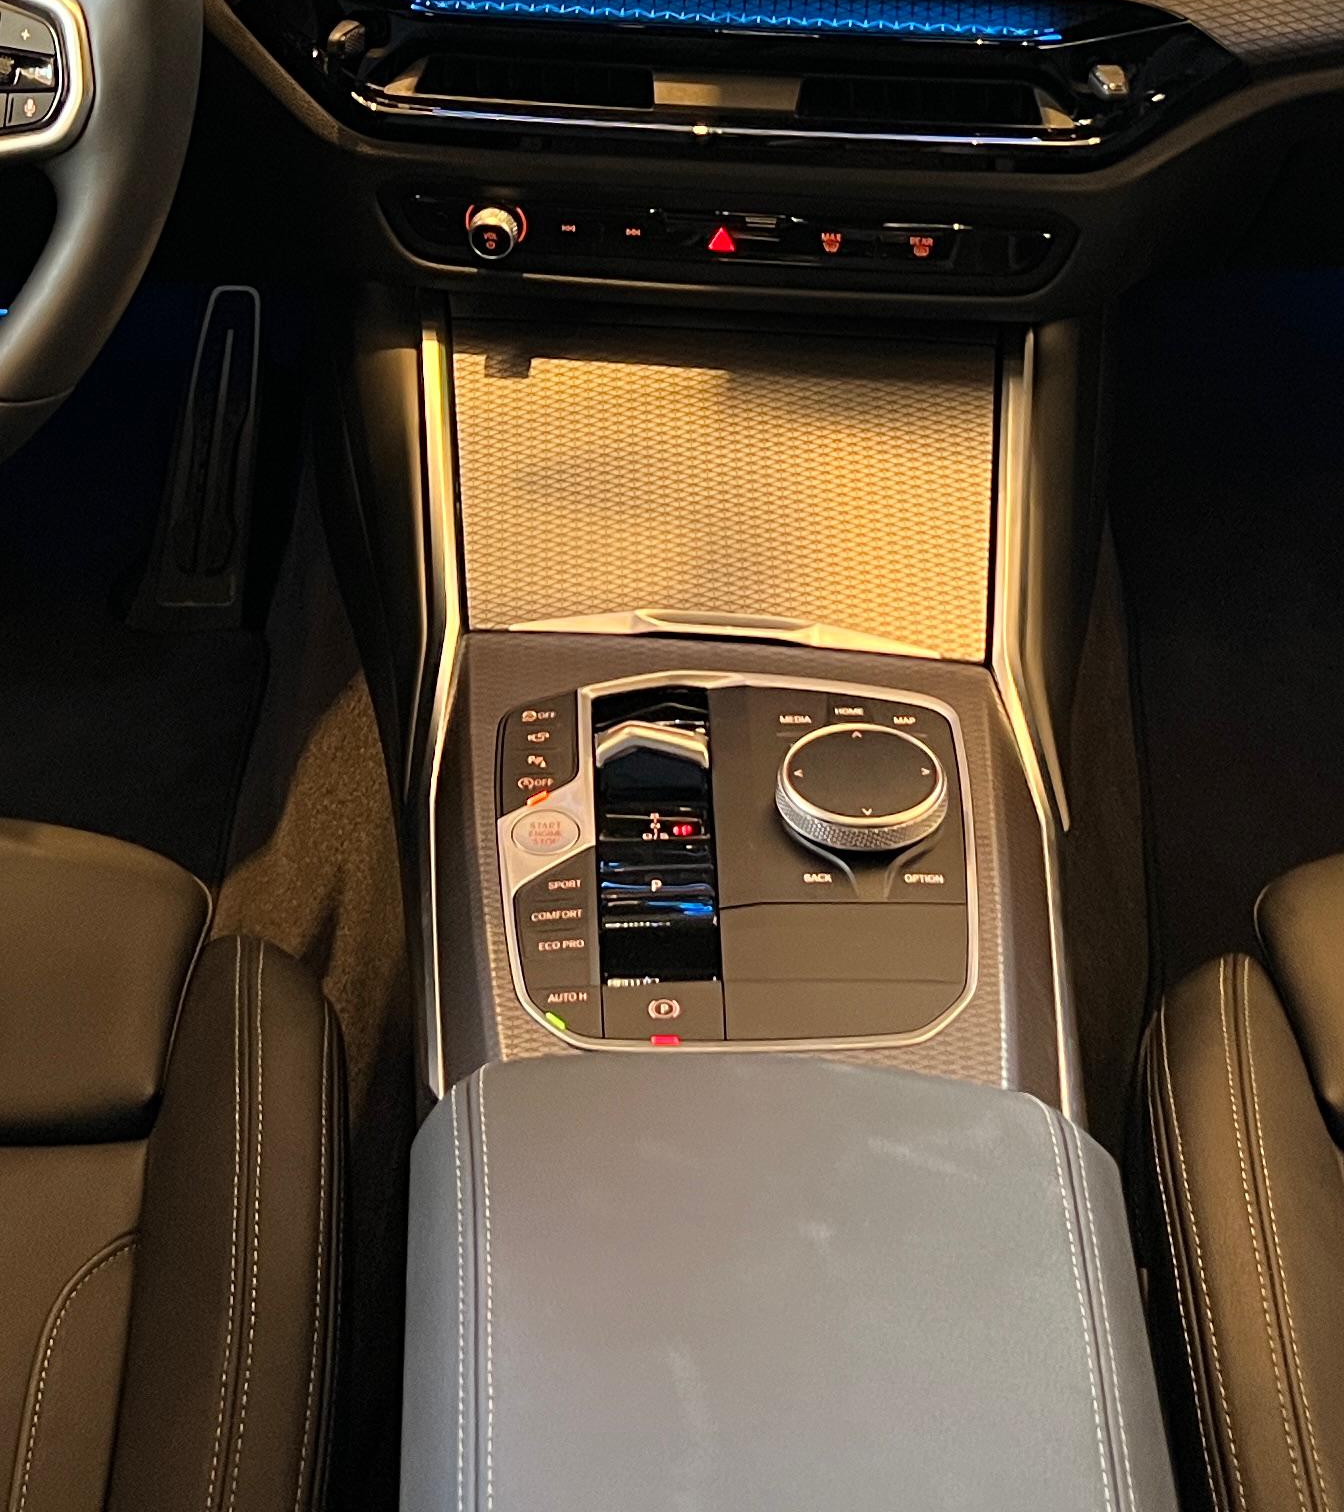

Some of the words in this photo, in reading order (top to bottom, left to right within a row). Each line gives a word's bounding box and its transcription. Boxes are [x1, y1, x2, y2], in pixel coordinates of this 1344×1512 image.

[834, 707, 865, 716] HOME
[779, 715, 812, 724] MEDIA
[893, 716, 916, 725] MAP
[534, 778, 554, 787] OFF
[803, 873, 832, 884] BACK
[904, 873, 944, 885] OPTION
[548, 879, 581, 890] SPORT
[531, 908, 583, 922] COMFORT
[538, 940, 561, 952] ECO
[562, 938, 585, 950] PRO
[547, 992, 577, 1003] AUTO
[578, 991, 587, 1002] H
